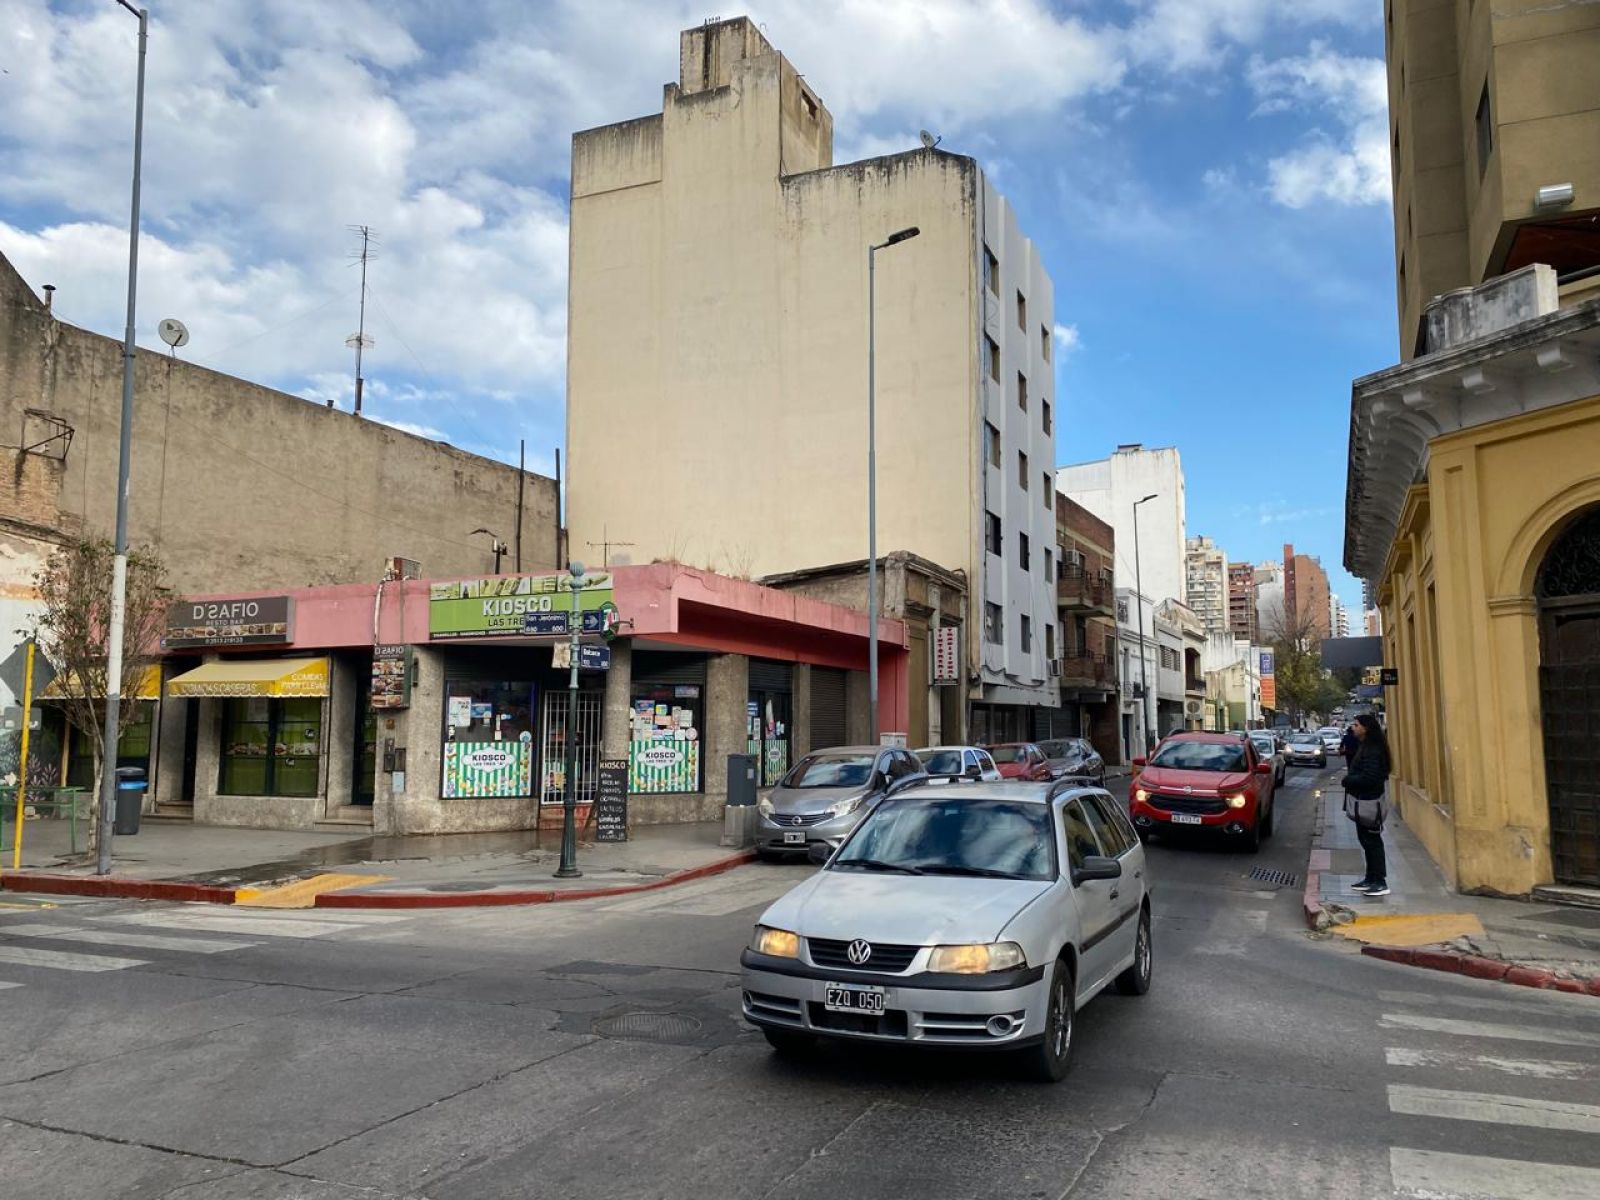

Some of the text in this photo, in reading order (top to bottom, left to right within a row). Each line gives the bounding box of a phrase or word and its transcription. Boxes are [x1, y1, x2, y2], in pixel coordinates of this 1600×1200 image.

[483, 596, 551, 616] KIOSCO
[489, 617, 524, 627] LAS TRE
[600, 761, 626, 769] KIOSCO
[859, 991, 882, 1010] 050
